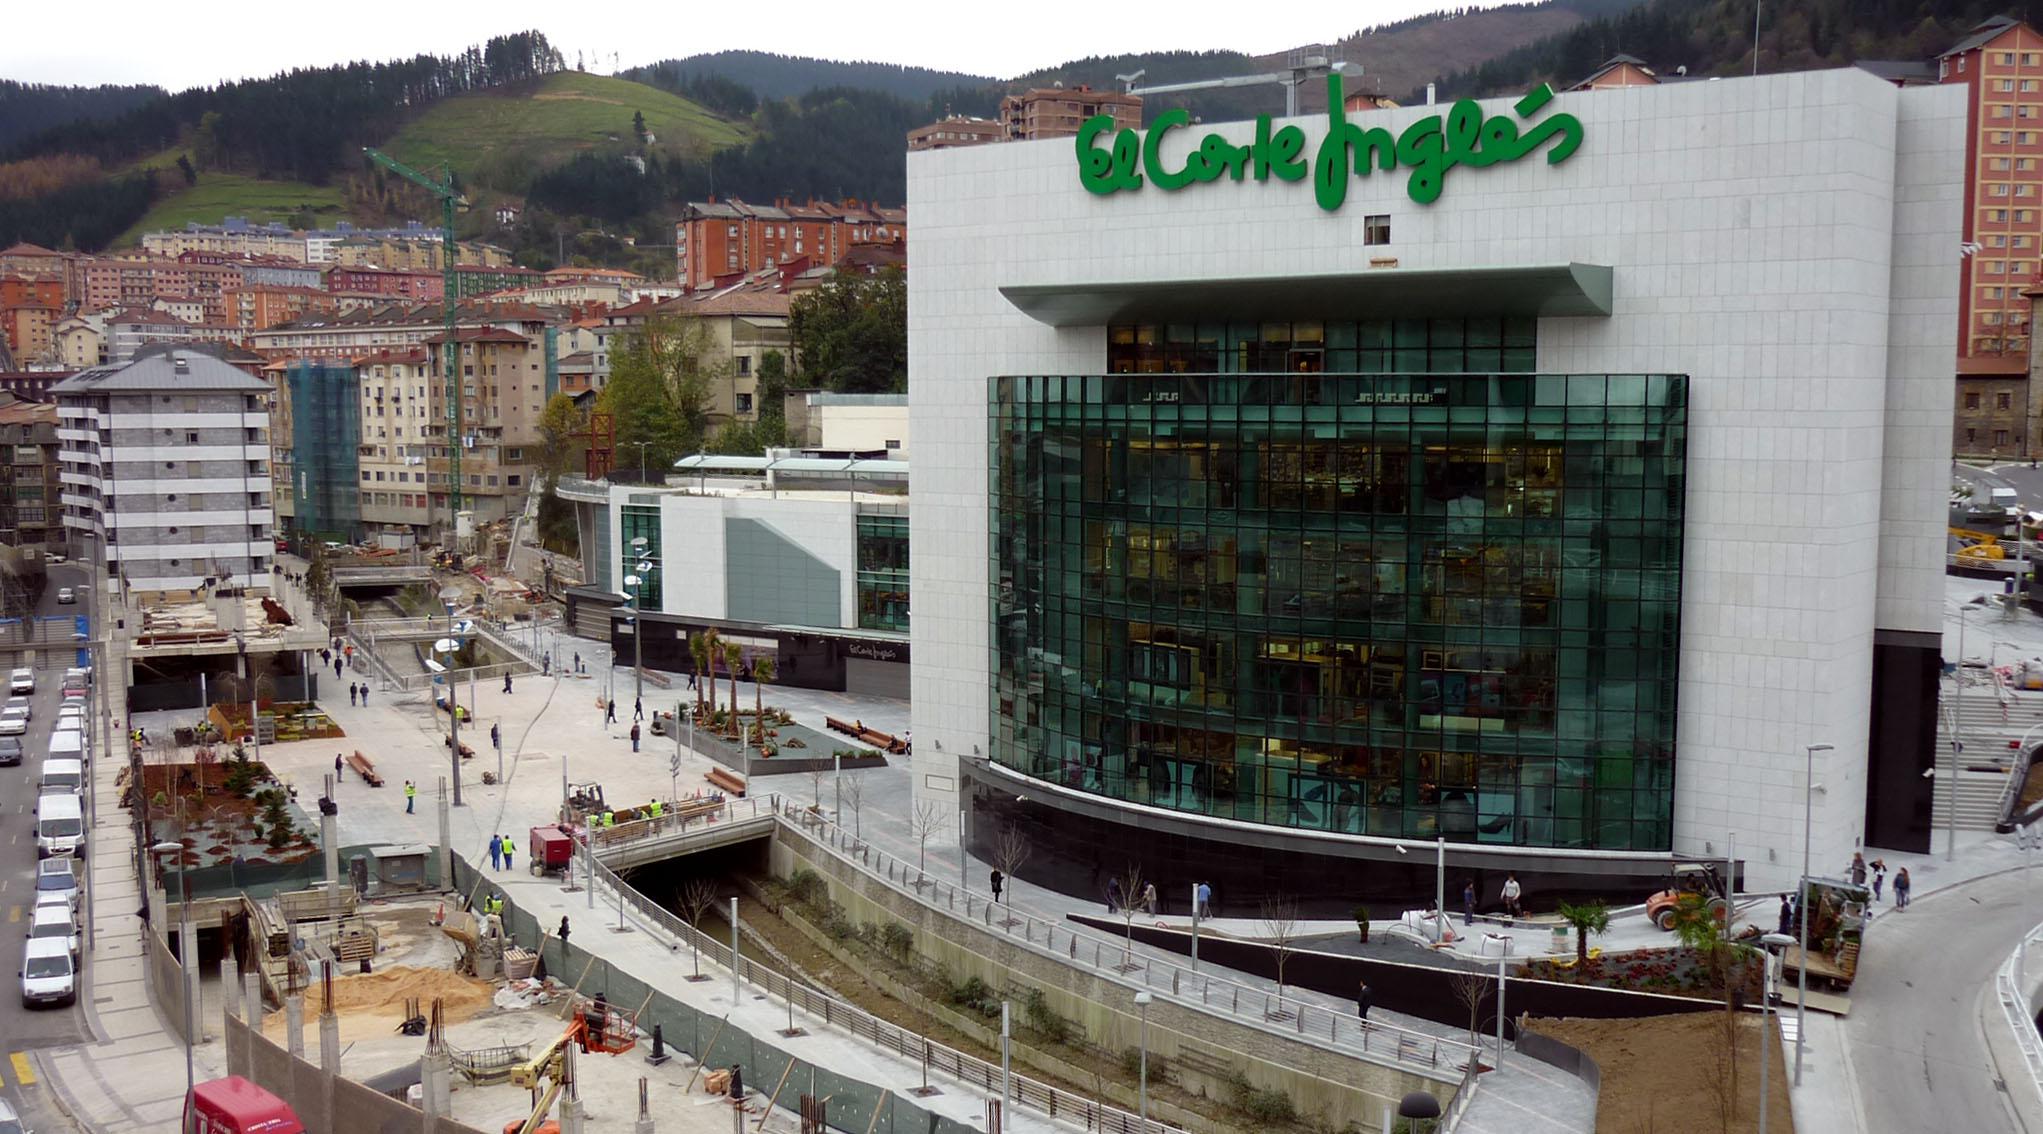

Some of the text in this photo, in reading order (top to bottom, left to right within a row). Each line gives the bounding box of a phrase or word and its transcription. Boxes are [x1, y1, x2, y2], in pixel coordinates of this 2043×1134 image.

[1076, 72, 1584, 211] El Corte Inglés
